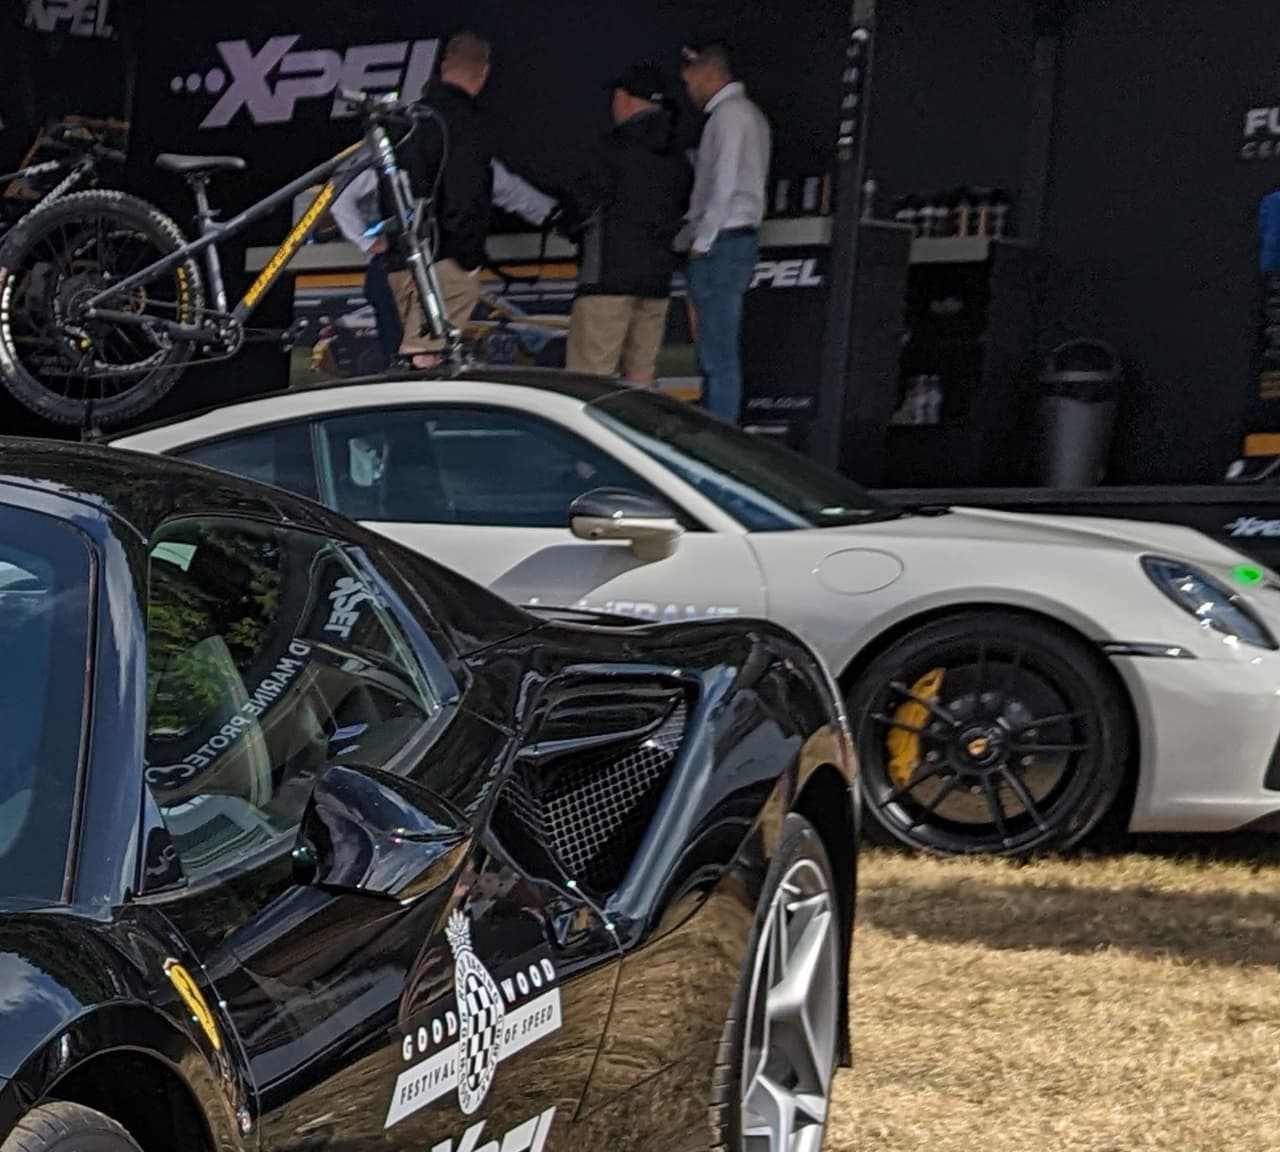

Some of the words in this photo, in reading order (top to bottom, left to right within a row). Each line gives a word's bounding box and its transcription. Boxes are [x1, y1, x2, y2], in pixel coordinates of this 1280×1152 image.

[748, 258, 824, 289] PEL
[500, 957, 555, 1003] WOOD
[400, 1059, 456, 1106] FESTIVAL
[504, 1024, 518, 1045] OF
[521, 1004, 554, 1036] SPEED
[402, 1010, 458, 1061] GOOD
